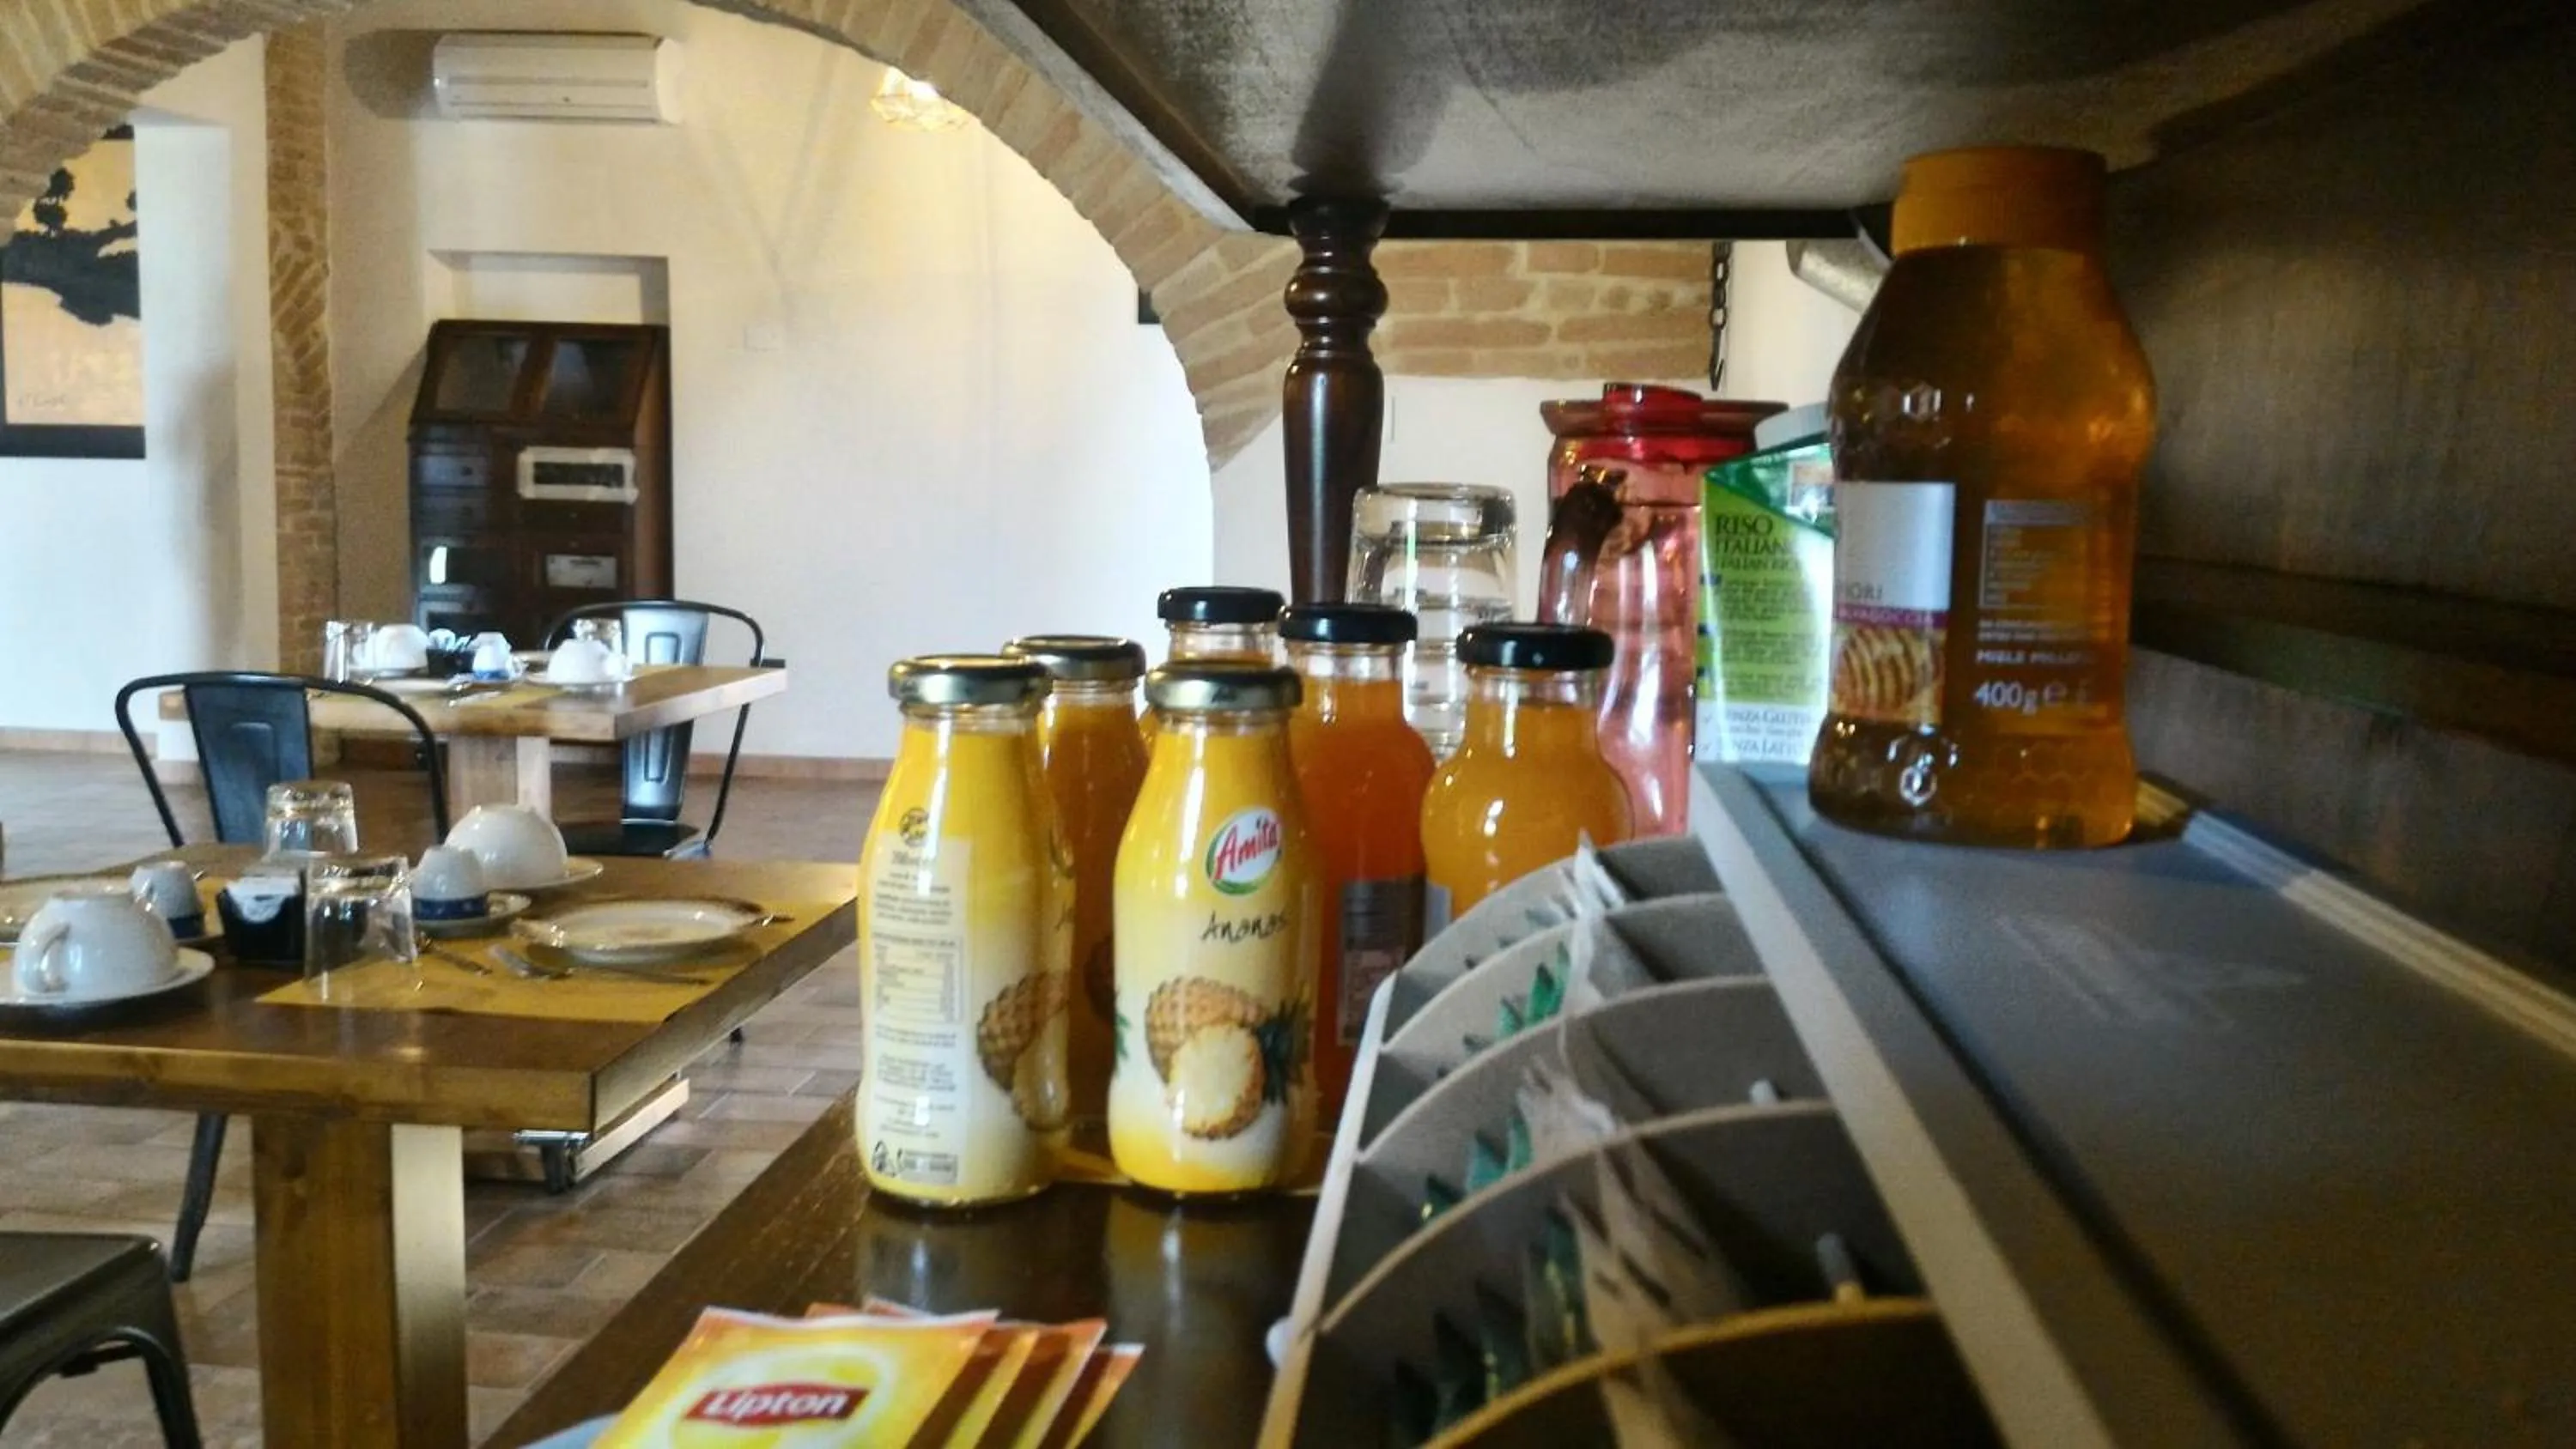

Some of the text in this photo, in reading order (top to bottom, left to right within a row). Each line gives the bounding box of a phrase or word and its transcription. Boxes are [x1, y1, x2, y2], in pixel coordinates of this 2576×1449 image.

[1716, 514, 1774, 536] RISO
[1716, 537, 1794, 555] ITALIAN
[1977, 650, 2025, 664] MIELE
[1972, 681, 2038, 715] 400g
[1214, 815, 1280, 880] Amita
[1200, 910, 1288, 943] Ananas
[702, 1389, 849, 1422] Lipton
